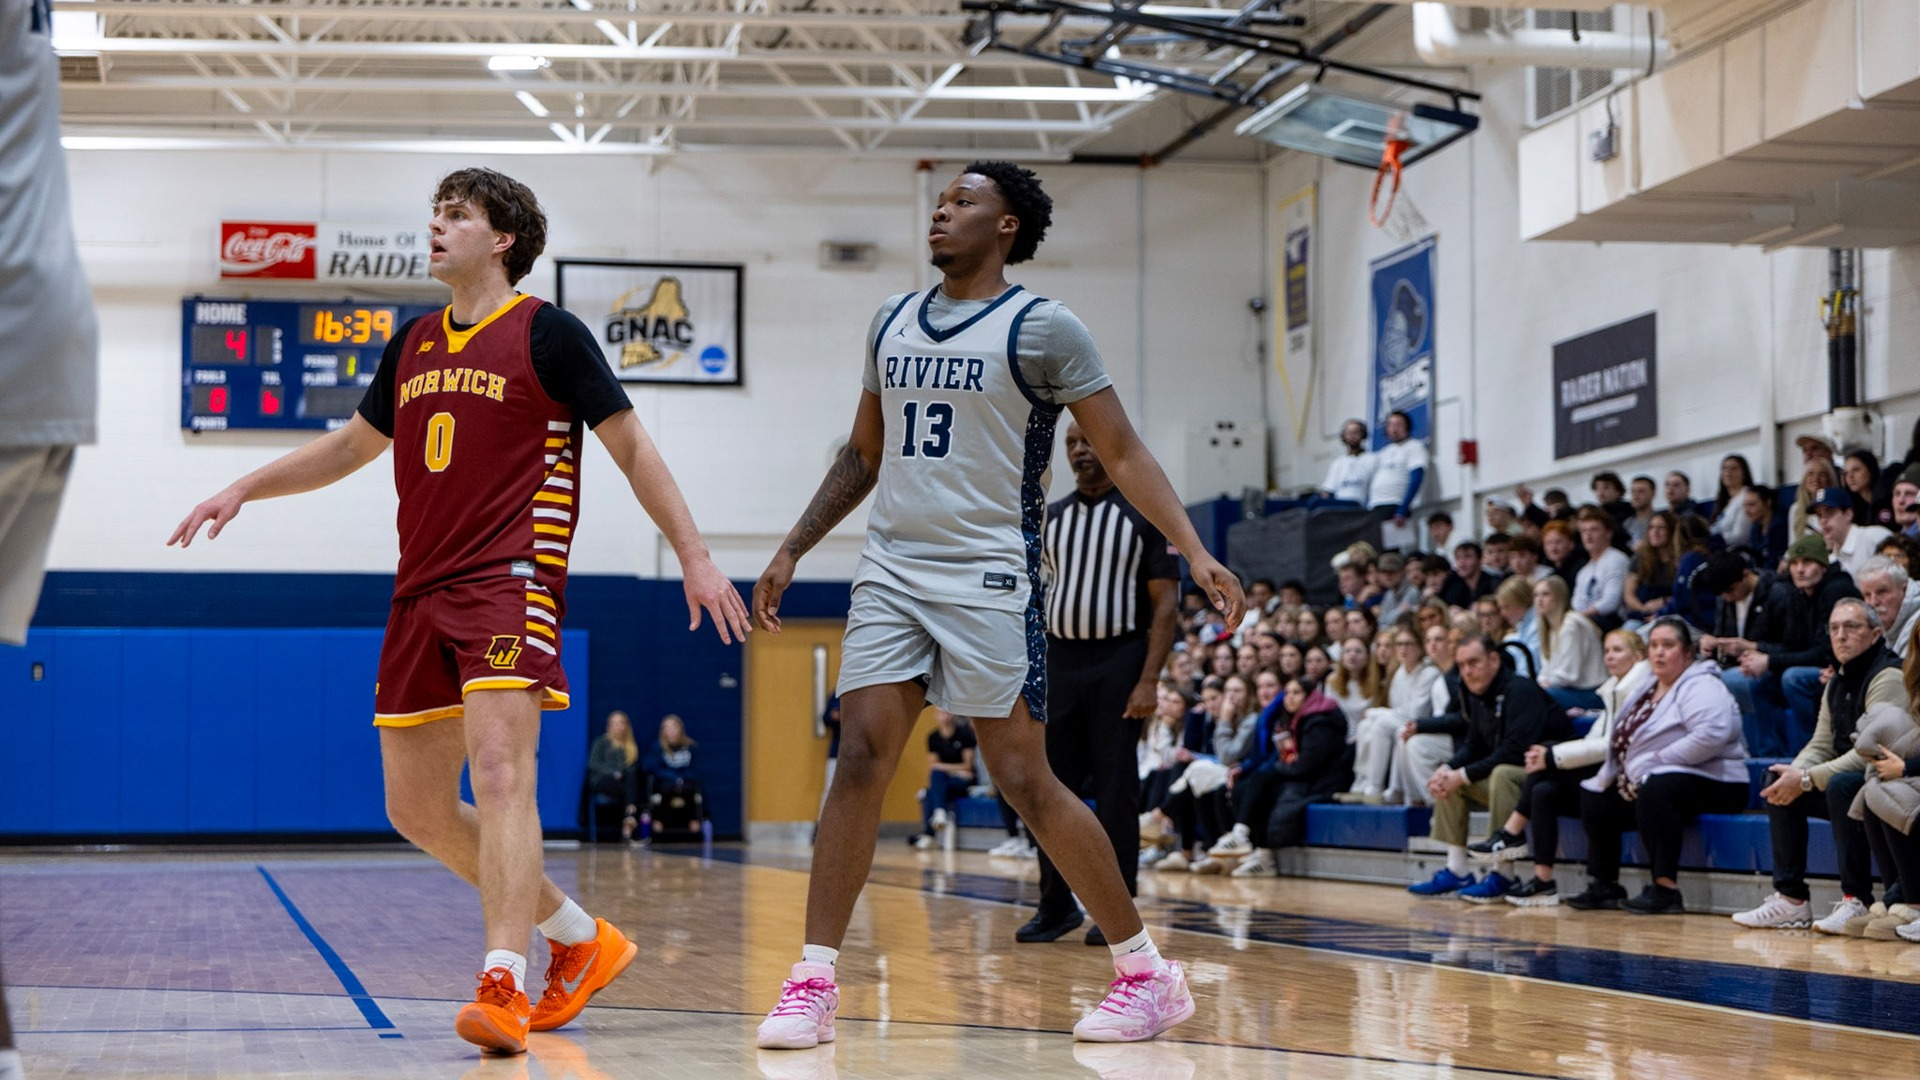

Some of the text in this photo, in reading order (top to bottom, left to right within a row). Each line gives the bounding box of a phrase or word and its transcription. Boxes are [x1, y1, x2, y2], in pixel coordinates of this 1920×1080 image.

[224, 231, 307, 264] Coca-Cola
[338, 231, 417, 248] Home Of
[328, 251, 432, 279] RAIDE
[195, 302, 247, 325] HOME
[313, 309, 393, 344] 16:39
[225, 330, 247, 360] 4
[606, 315, 694, 345] GNAC
[399, 367, 507, 409] NORWICH
[884, 354, 986, 393] RIVIER
[208, 387, 227, 414] 0
[425, 411, 456, 473] 0
[901, 400, 955, 460] 13
